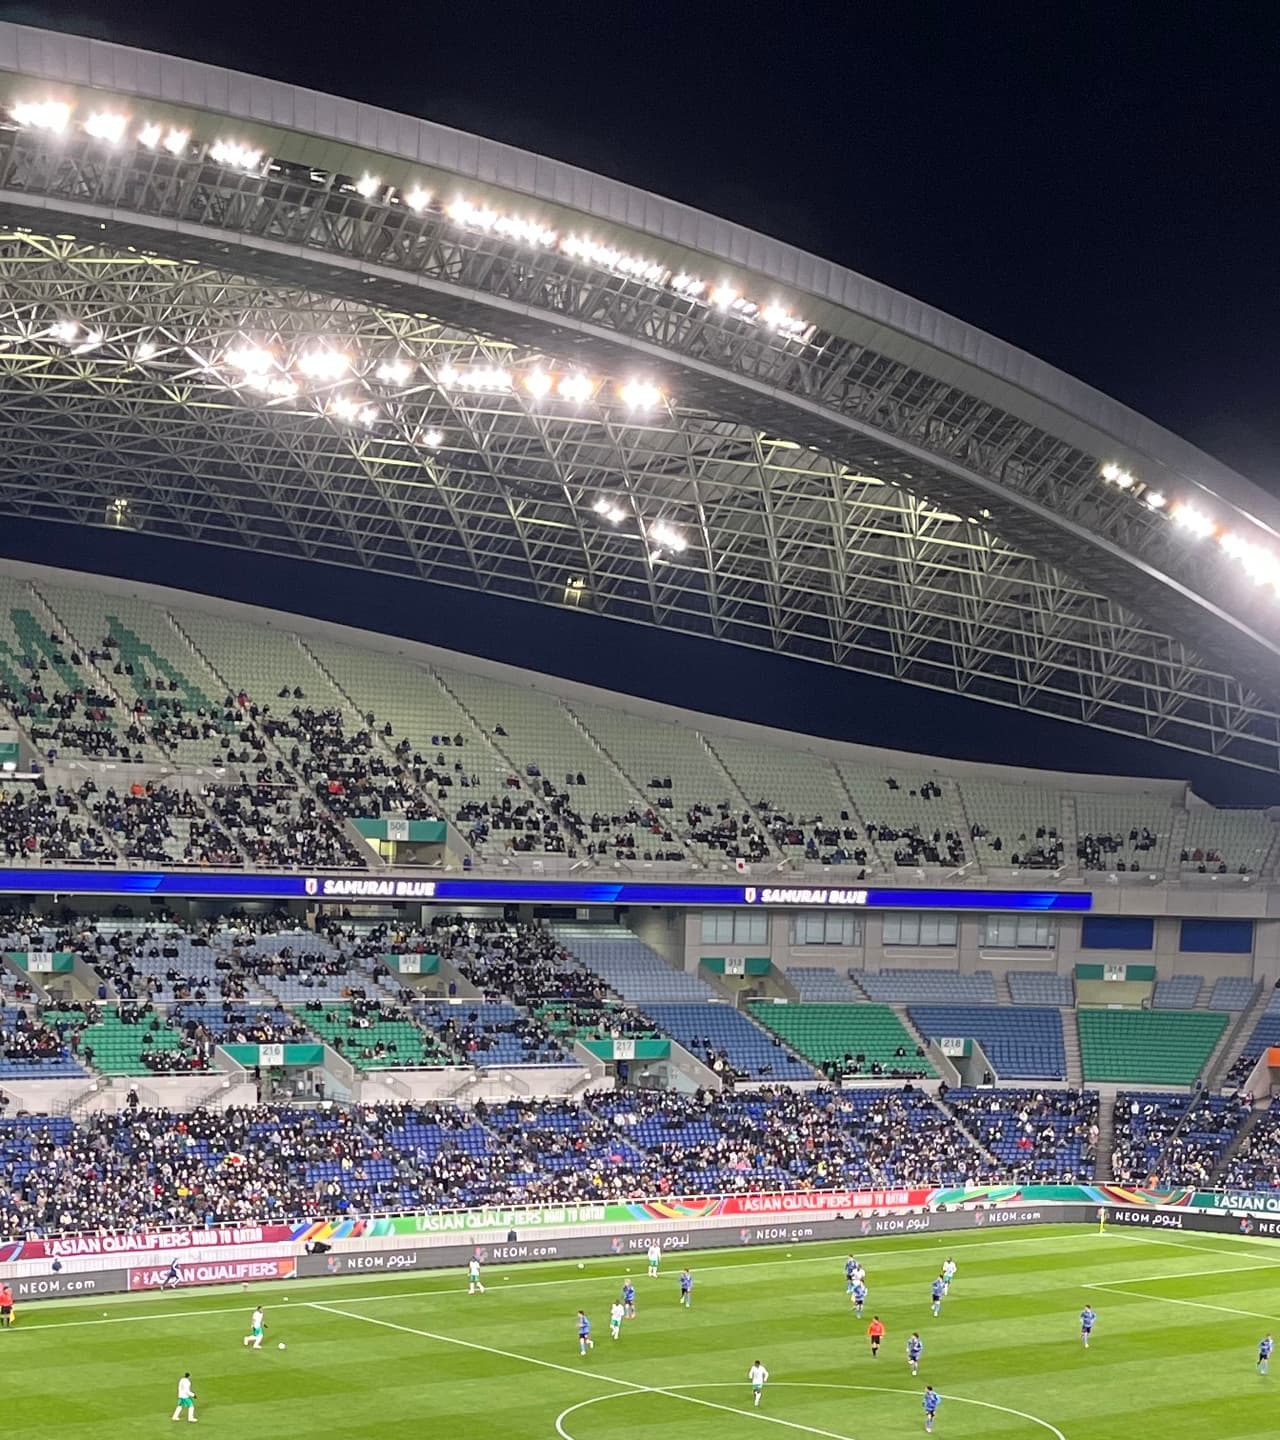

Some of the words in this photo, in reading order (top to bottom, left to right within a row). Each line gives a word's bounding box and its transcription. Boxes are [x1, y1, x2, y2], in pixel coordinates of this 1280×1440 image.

[323, 880, 394, 895] SAMURAI
[396, 882, 436, 896] BLUE
[761, 889, 828, 903] SAMURAI
[828, 890, 868, 904] BLUE
[263, 1046, 280, 1056] 216
[616, 1041, 632, 1051] 217
[943, 1039, 961, 1048] 218
[743, 1197, 782, 1212] ASIAN
[784, 1194, 852, 1210] QUALIFIERS
[1220, 1195, 1265, 1212] ASIAN
[424, 1215, 465, 1231] ASIAN
[466, 1210, 542, 1228] QUALIFIERS
[1115, 1211, 1150, 1223] NEOM
[876, 1220, 904, 1232] NEOM
[52, 1238, 101, 1256] ASIAN
[103, 1230, 191, 1252] QUALIFIERS
[493, 1246, 557, 1259] NEOM.com
[347, 1257, 384, 1269] NEOM
[150, 1266, 195, 1285] ASAN
[198, 1262, 278, 1281] QUALIFIERS
[19, 1279, 96, 1295] NEOM.com
